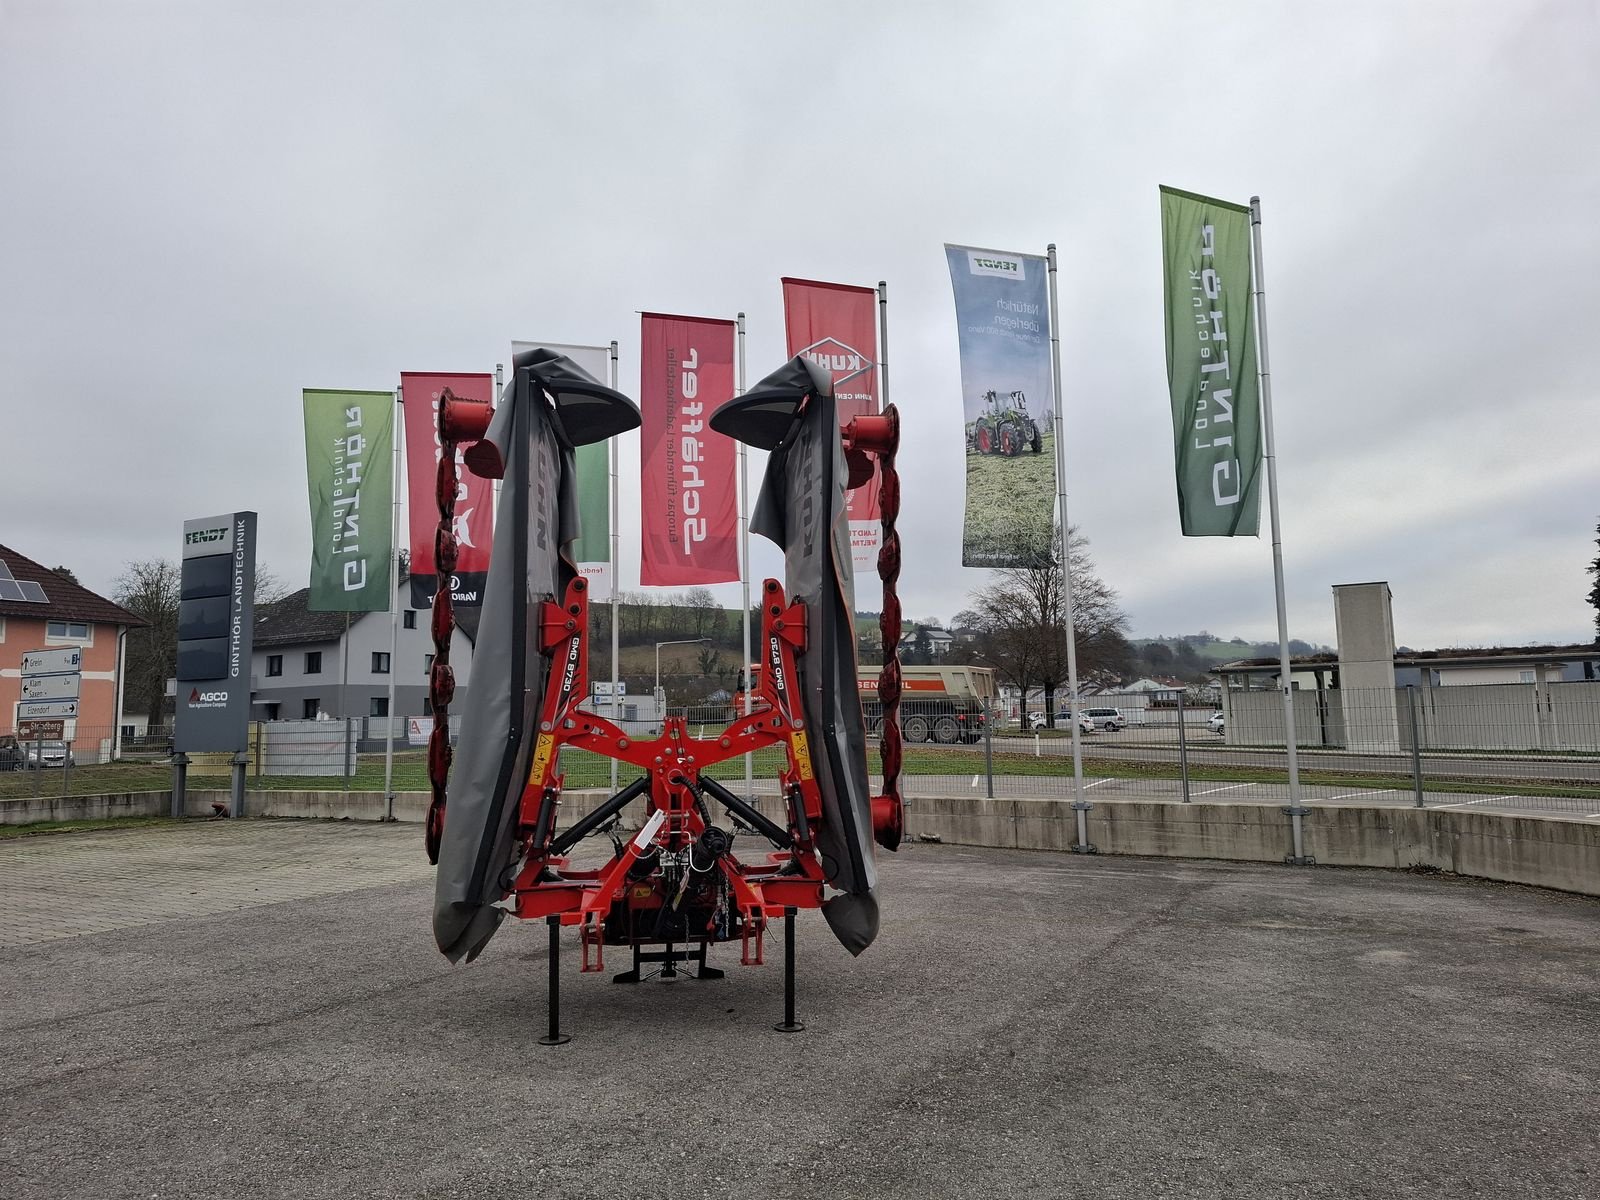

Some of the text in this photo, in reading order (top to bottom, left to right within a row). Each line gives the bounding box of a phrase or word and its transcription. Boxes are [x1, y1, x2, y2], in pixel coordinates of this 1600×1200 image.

[185, 528, 229, 545] FENDT
[231, 519, 246, 678] GINTHÖR LANDTECHNIK
[563, 637, 580, 692] GMD 8730
[770, 637, 785, 690] GMD 8730
[200, 691, 228, 701] AGCO
